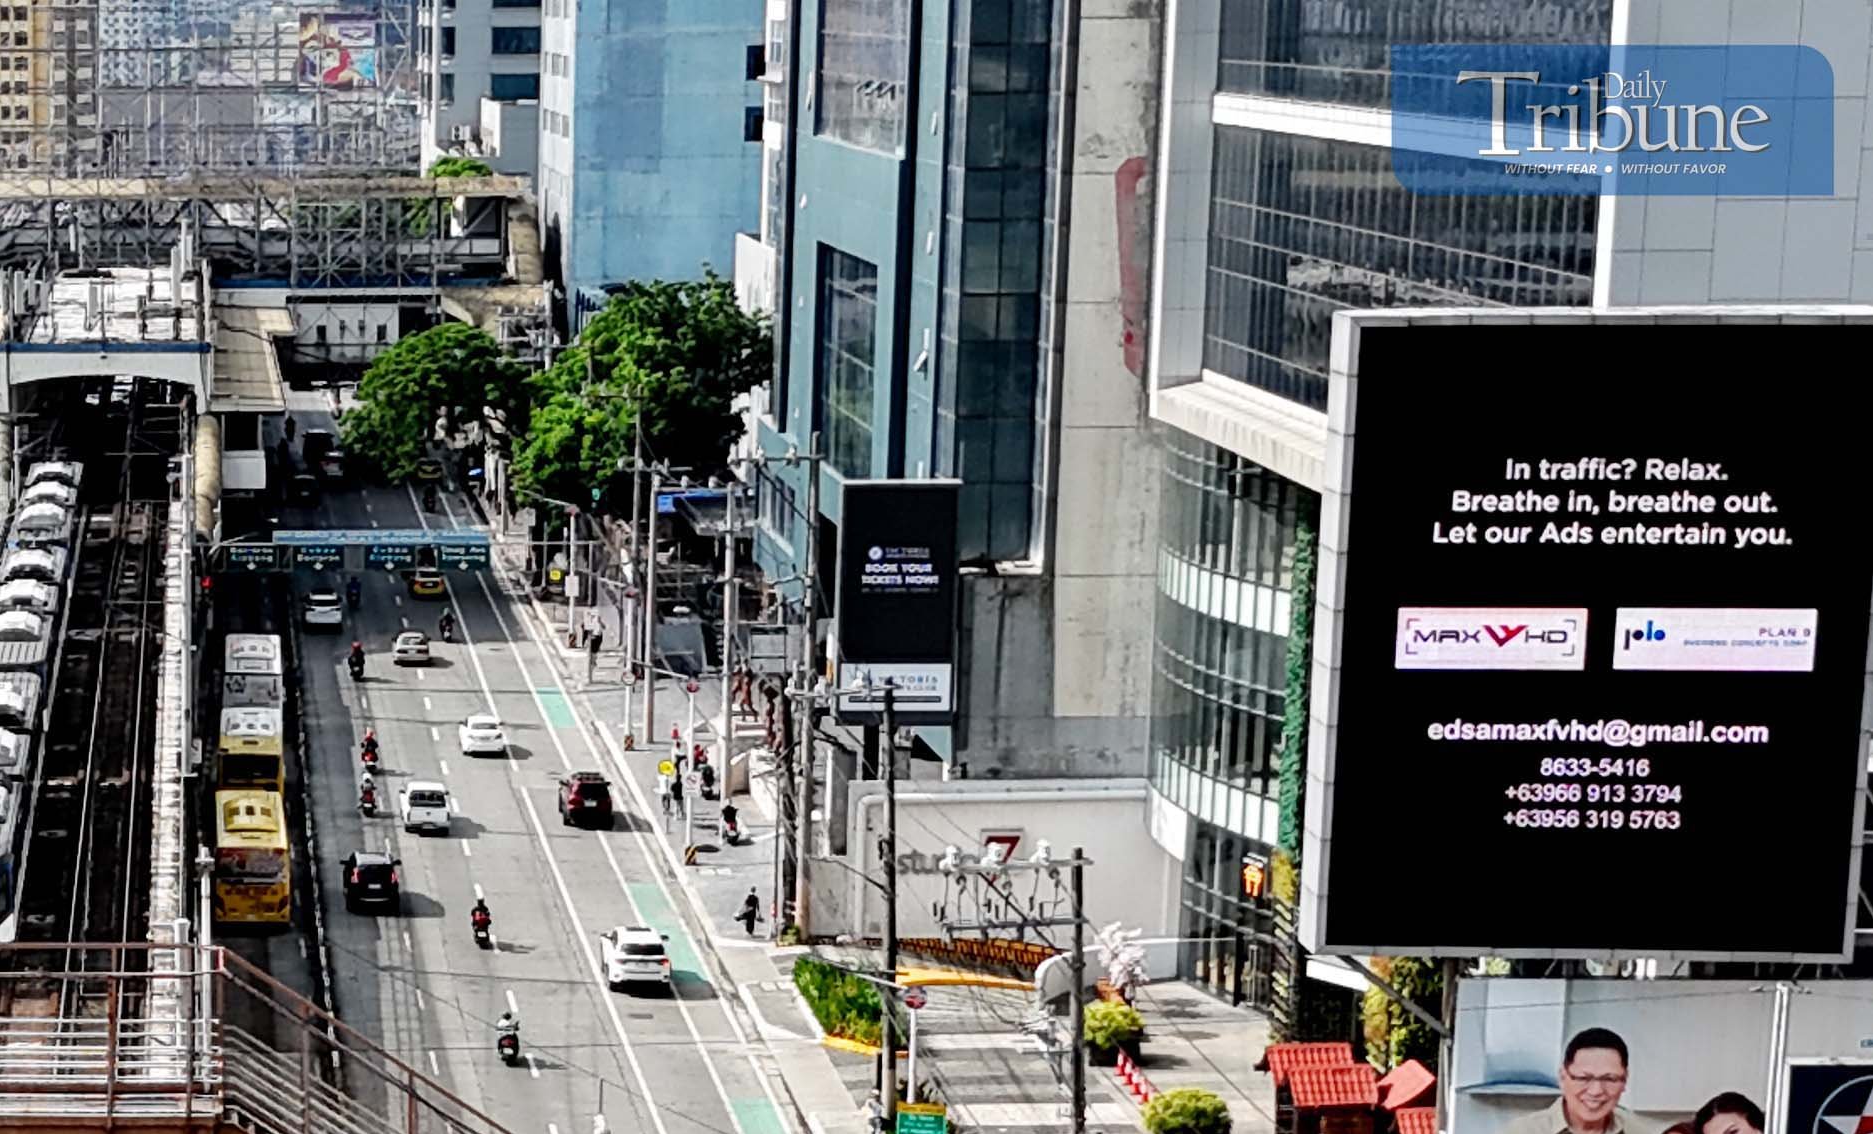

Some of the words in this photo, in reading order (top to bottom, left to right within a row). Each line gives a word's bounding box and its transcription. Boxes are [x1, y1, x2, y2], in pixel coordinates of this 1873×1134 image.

[1506, 459, 1530, 480] In
[1539, 458, 1637, 480] traffic?
[1645, 458, 1728, 480] Relax.
[1452, 490, 1559, 512] Breathe
[1568, 490, 1599, 515] in,
[1608, 490, 1716, 512] breathe
[1724, 492, 1777, 513] out.
[1433, 522, 1477, 543] Let
[1485, 526, 1532, 543] our
[1540, 522, 1593, 544] Ads
[1601, 522, 1726, 544] entertain
[1735, 528, 1792, 548] you.
[1759, 627, 1797, 638] PLAN
[1428, 718, 1769, 747] edsamaxfvhd@gmail.com
[1540, 758, 1650, 777] 8633-5416
[1505, 784, 1581, 803] +63966
[1587, 784, 1625, 803] 913
[1631, 785, 1681, 803] 3794
[1504, 809, 1579, 828] +63956
[1586, 810, 1624, 829] 319
[1629, 811, 1680, 830] 5763
